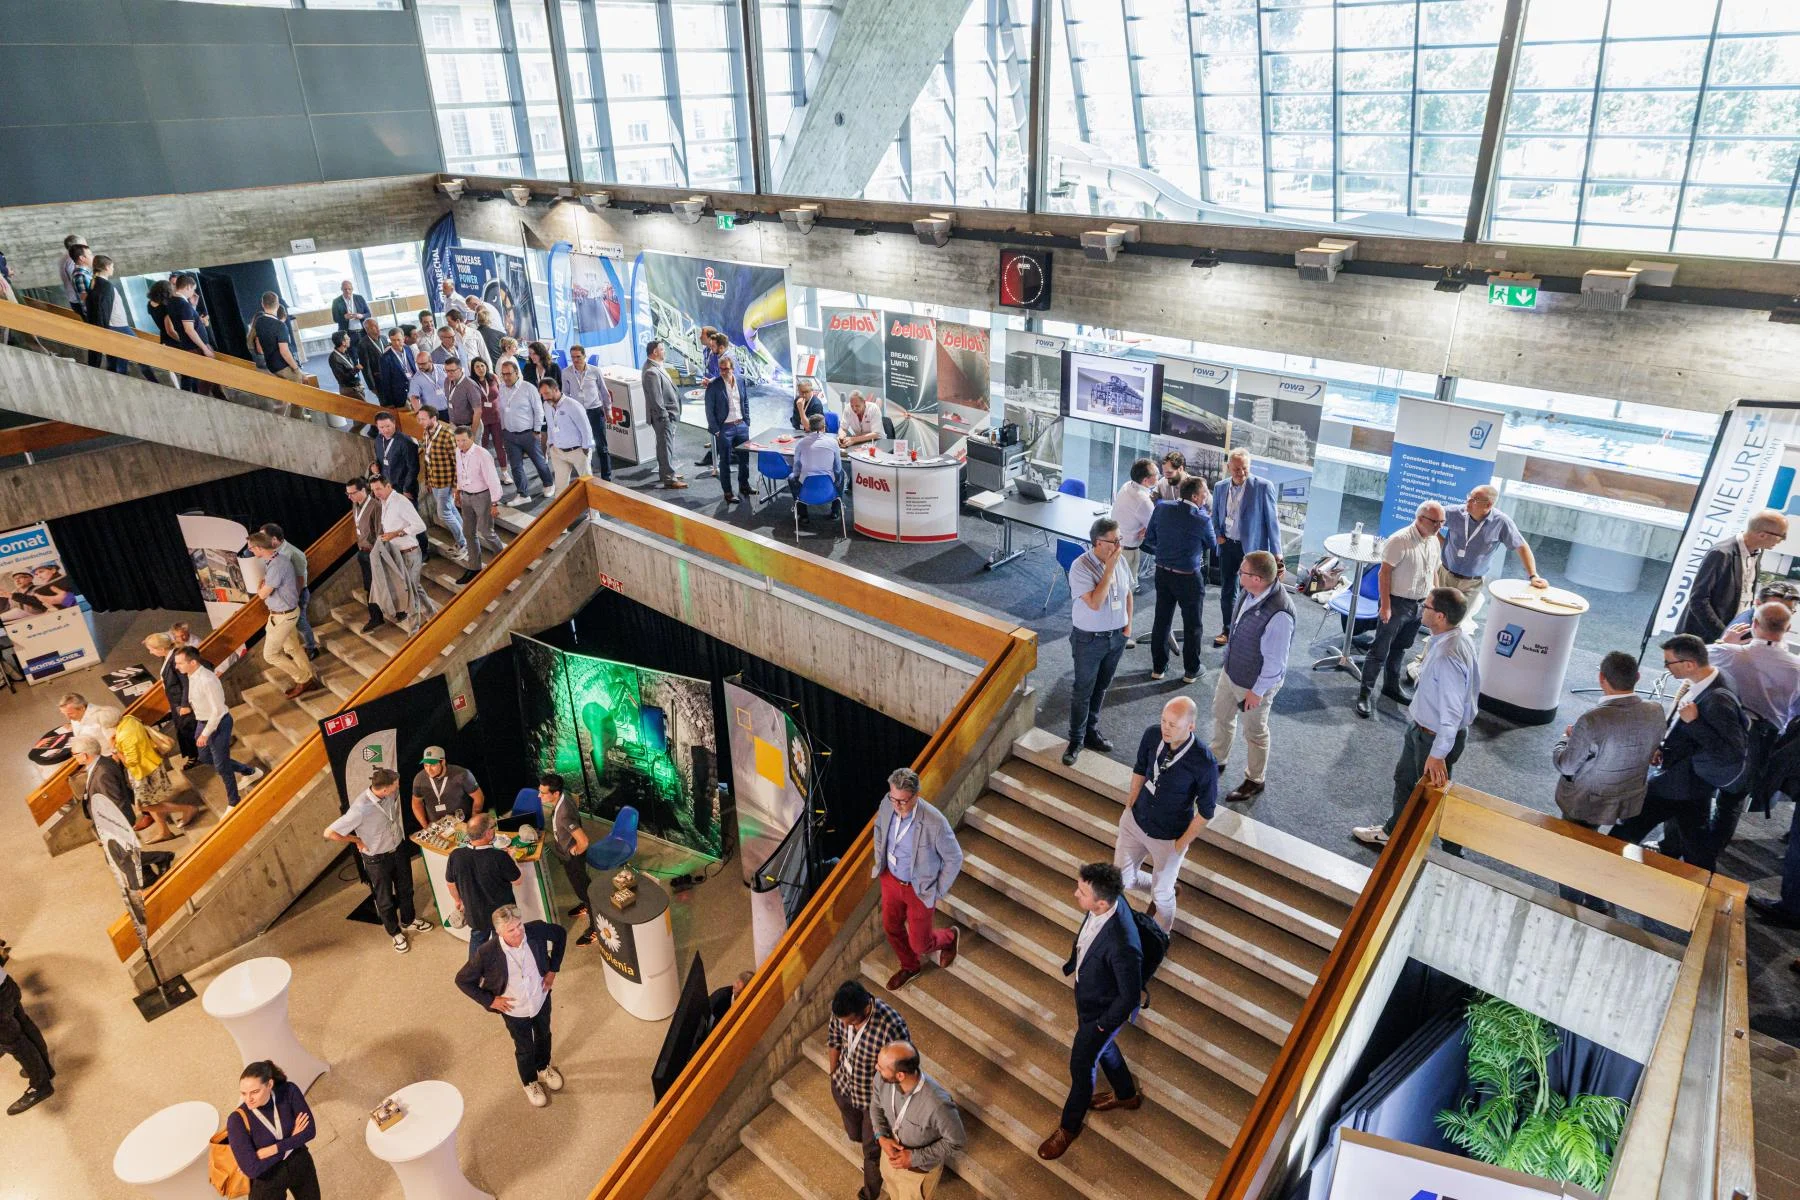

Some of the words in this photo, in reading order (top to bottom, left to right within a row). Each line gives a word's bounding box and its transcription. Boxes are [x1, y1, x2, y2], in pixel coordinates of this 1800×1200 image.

[455, 254, 482, 266] INCREASE
[457, 263, 471, 274] YOUR
[459, 273, 479, 284] POWER
[828, 309, 880, 333] belloli
[891, 318, 937, 341] belloli
[942, 329, 988, 353] belloli
[1035, 338, 1054, 348] rowa
[890, 351, 919, 362] BREAKING
[890, 359, 909, 369] LIMITS
[1192, 365, 1215, 378] rowa
[1278, 380, 1305, 392] rowa
[1402, 453, 1440, 467] Construction
[1441, 461, 1467, 472] Sectors:
[1404, 462, 1430, 473] Conveyor
[1430, 469, 1454, 478] systems
[855, 472, 891, 493] belloli
[1403, 470, 1430, 481] Formwork
[1436, 478, 1457, 487] special
[0, 534, 46, 554] omat
[600, 946, 635, 977] mplenia
